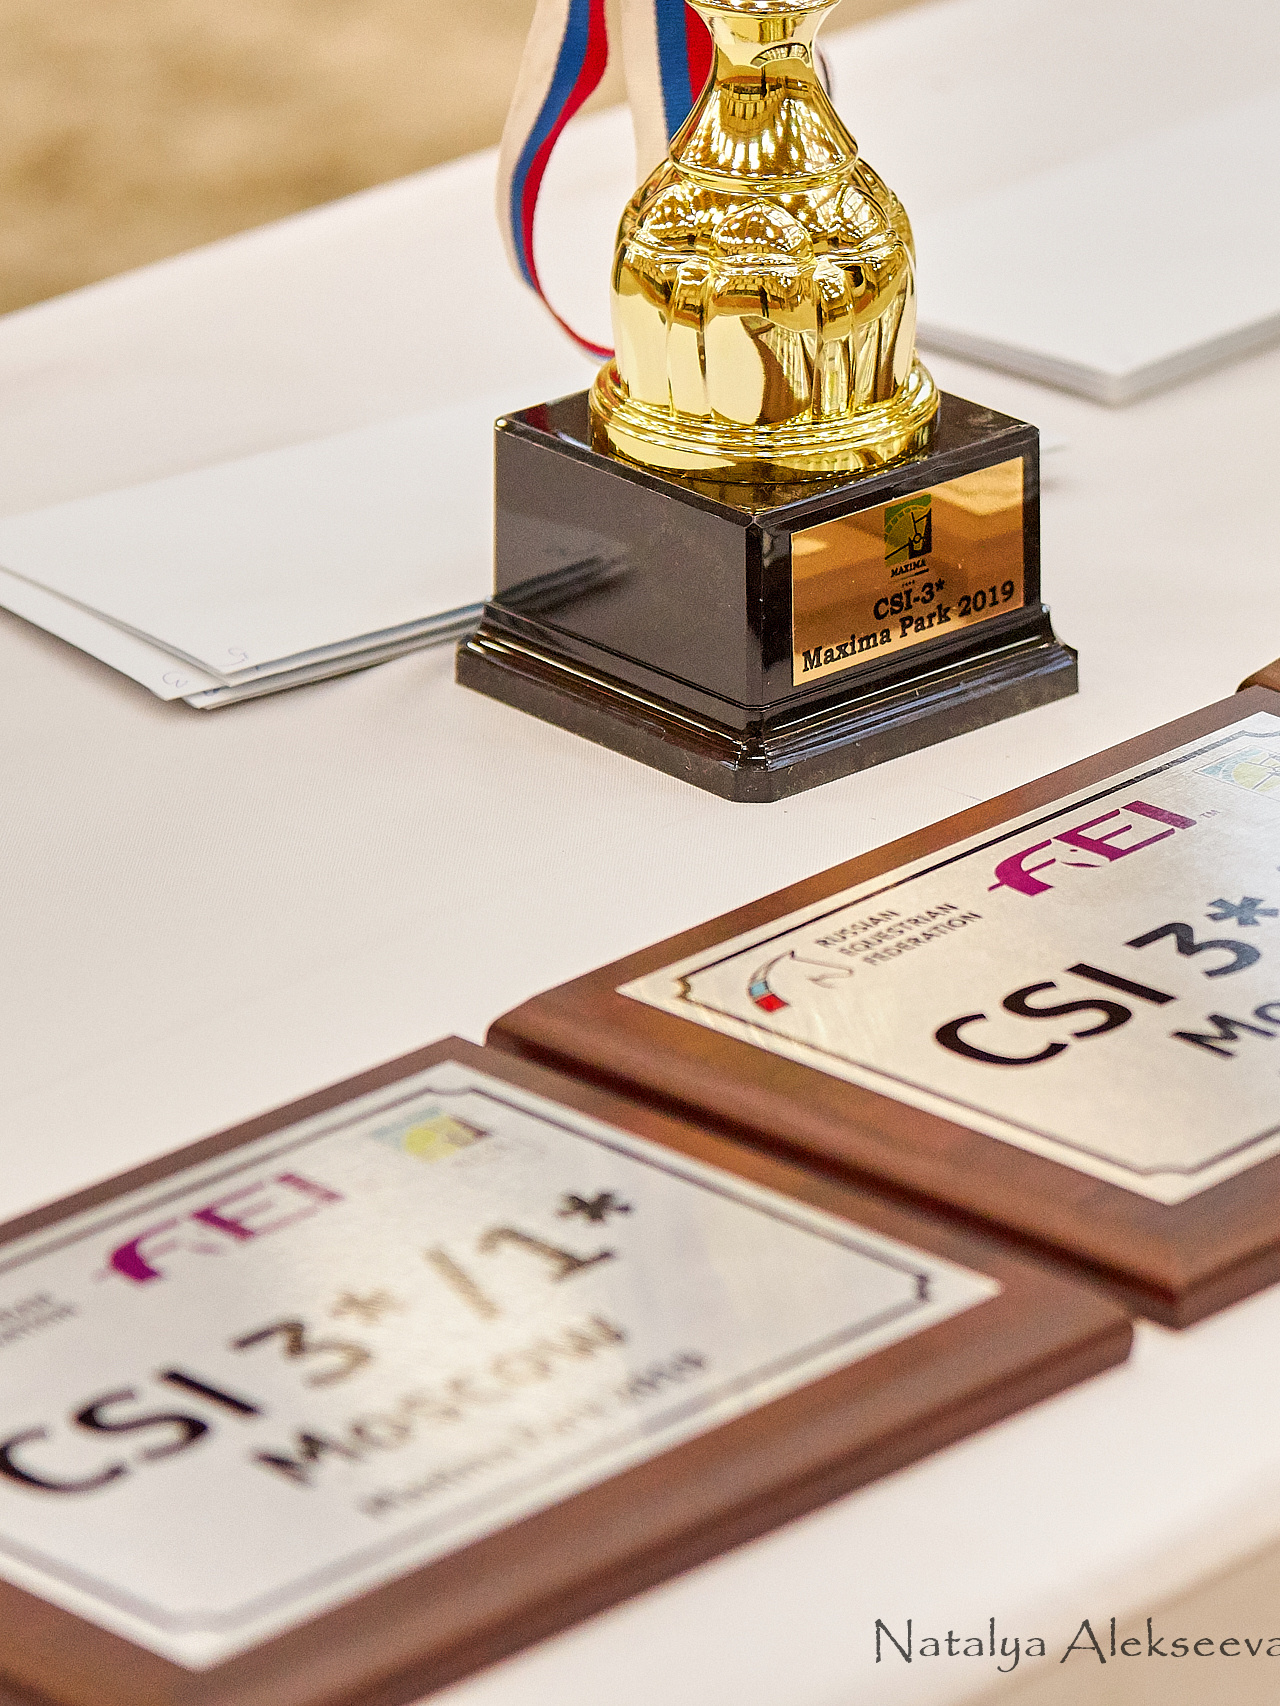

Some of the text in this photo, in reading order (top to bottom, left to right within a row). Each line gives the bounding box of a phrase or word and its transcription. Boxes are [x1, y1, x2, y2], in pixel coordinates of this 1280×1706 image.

[802, 579, 1016, 673] Maxima Park 2019
[988, 800, 1196, 897] FEI
[814, 909, 901, 949] RUSSIAN
[838, 902, 959, 957] EQUESTRIAN
[861, 910, 984, 966] FEDERATION
[934, 962, 1178, 1067] CSI
[0, 1366, 264, 1494] CSI
